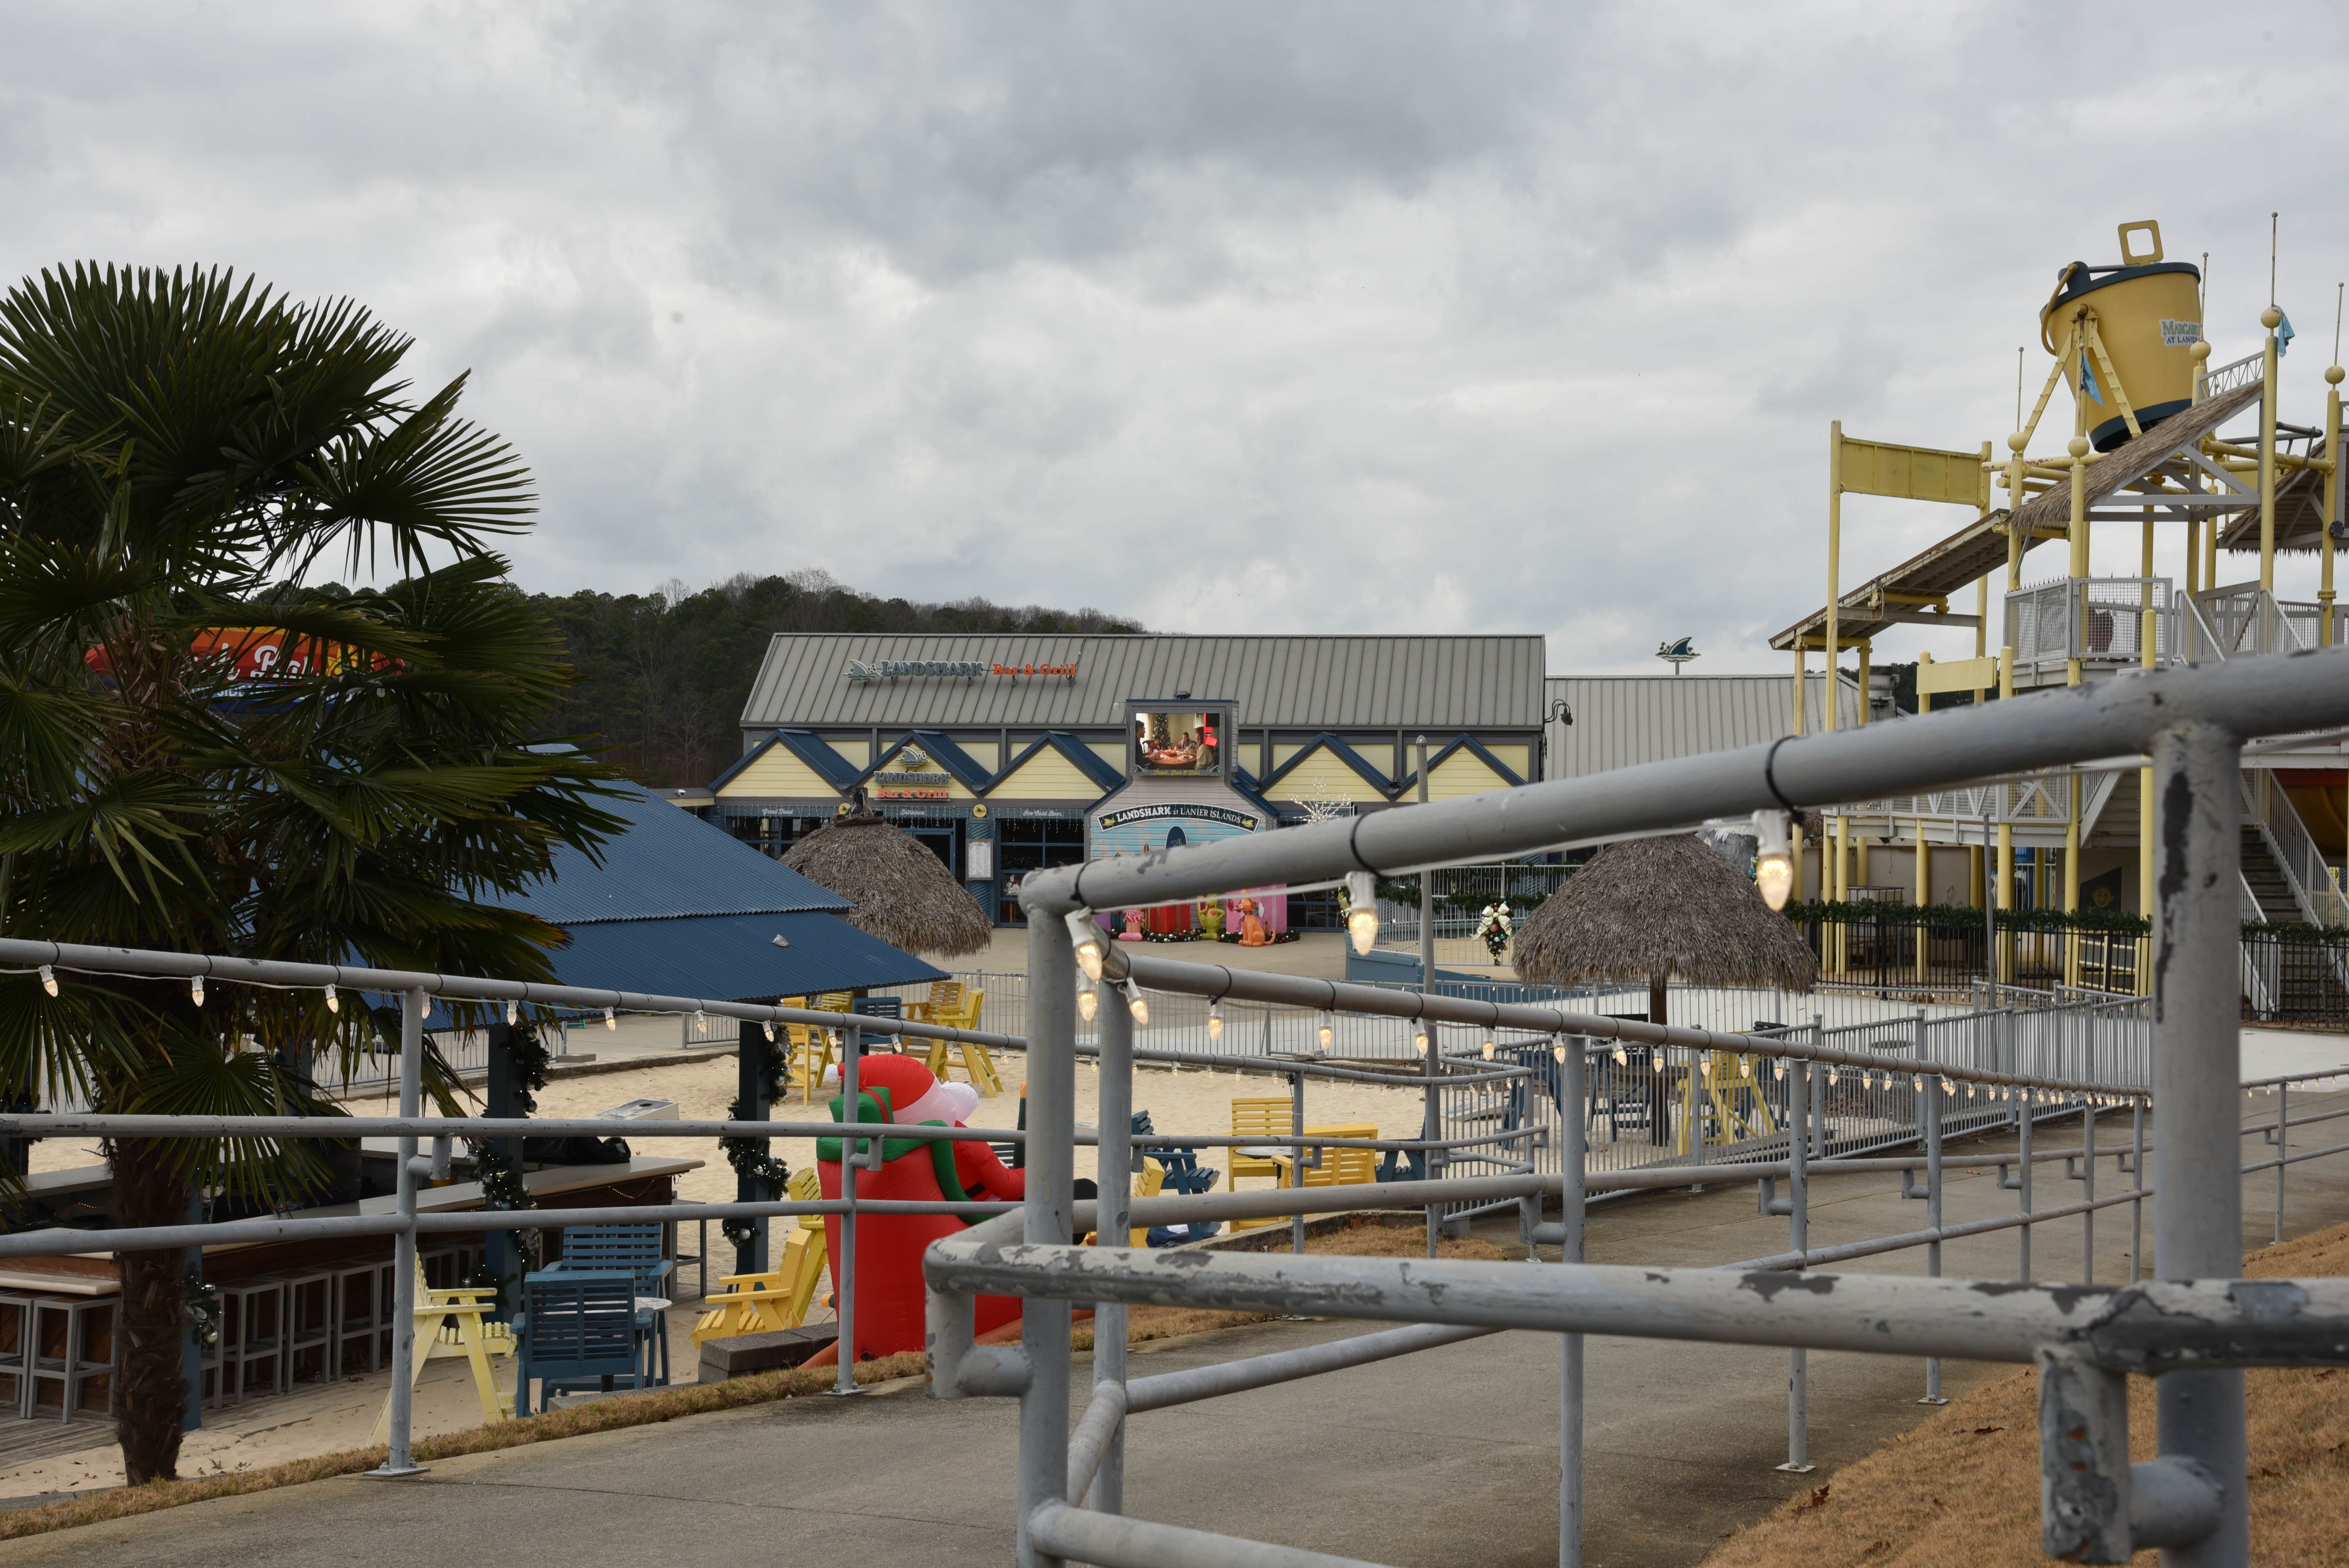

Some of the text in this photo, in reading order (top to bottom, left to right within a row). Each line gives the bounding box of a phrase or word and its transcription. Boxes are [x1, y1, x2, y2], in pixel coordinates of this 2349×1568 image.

[881, 661, 1076, 676] LANDSHARK Bar & Grill
[874, 771, 951, 784] LANDSHARK
[877, 789, 947, 798] Bar & Grill
[1116, 806, 1171, 822] LANDSHARK
[1180, 807, 1208, 817] LANIER
[1210, 807, 1242, 824] ISLANDS
